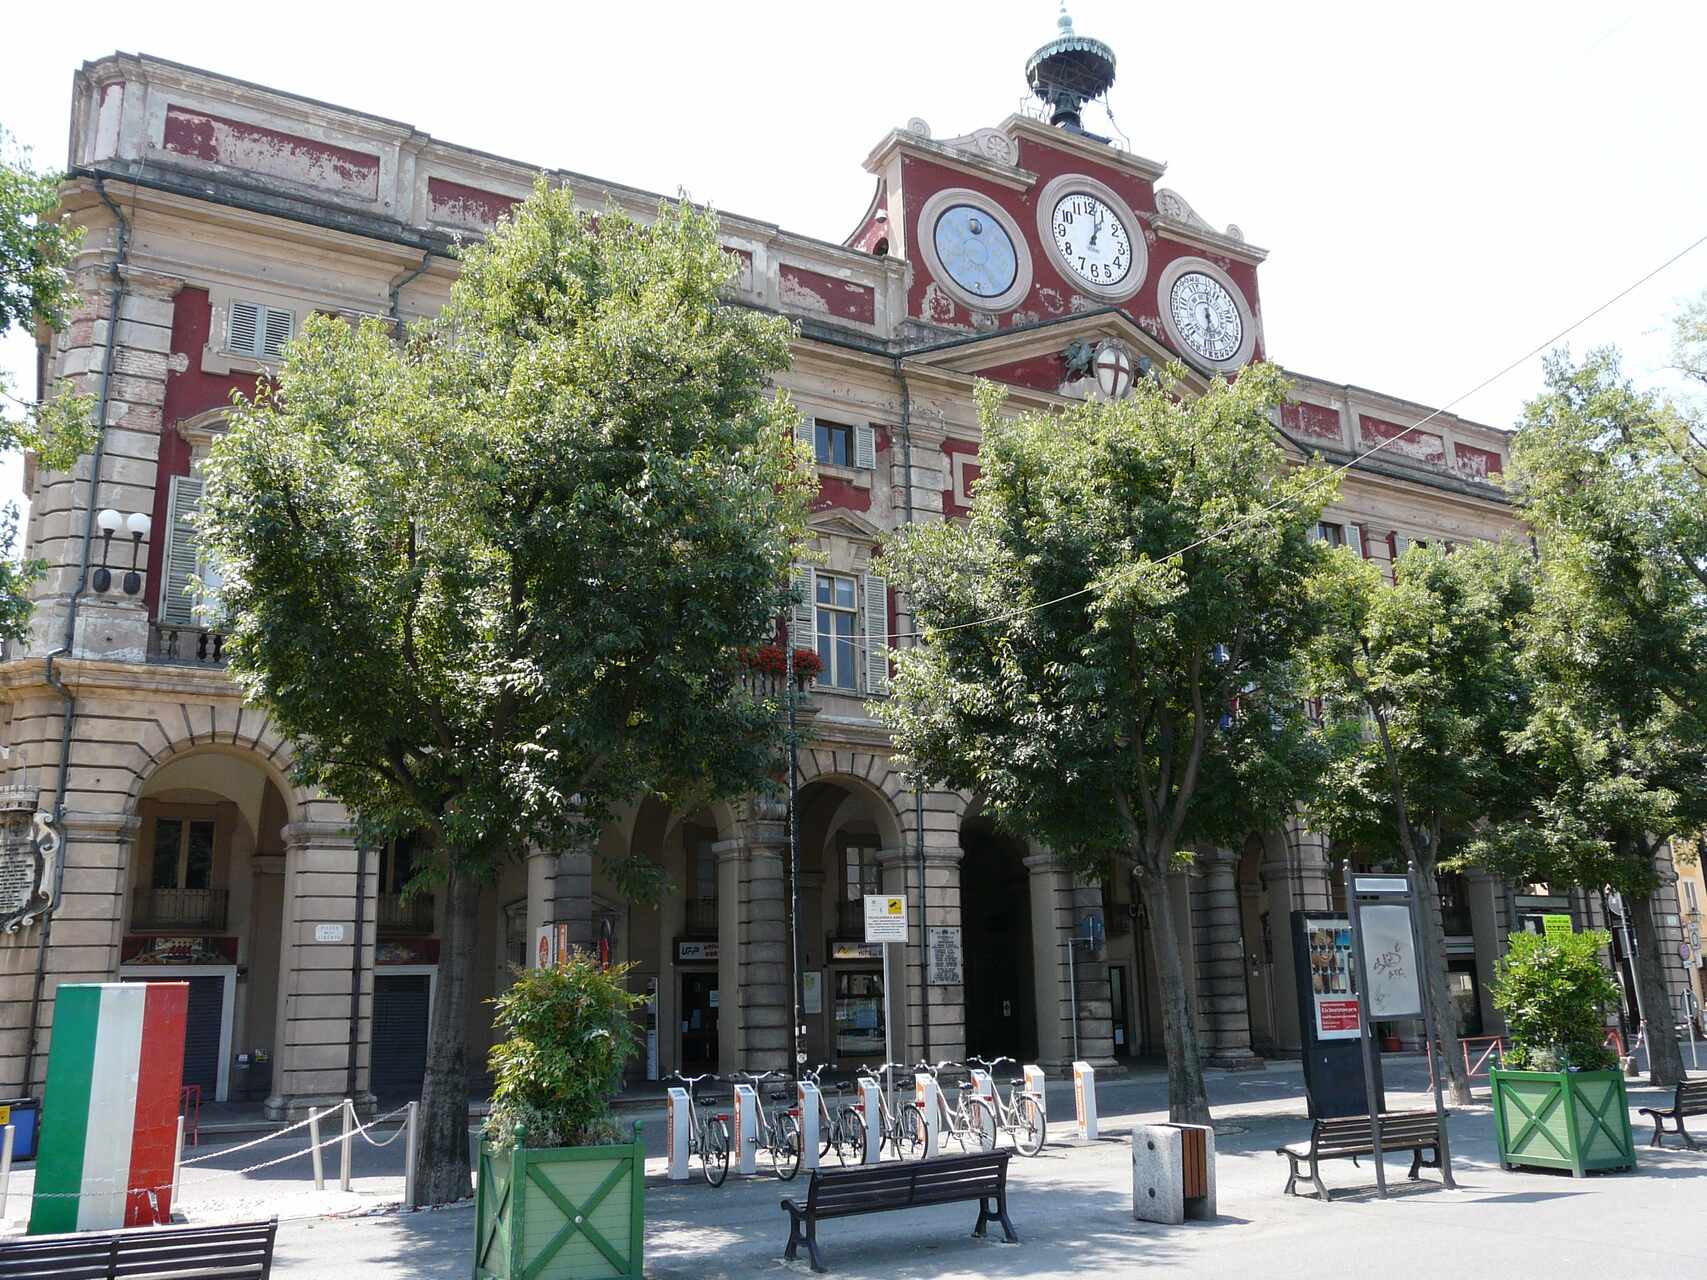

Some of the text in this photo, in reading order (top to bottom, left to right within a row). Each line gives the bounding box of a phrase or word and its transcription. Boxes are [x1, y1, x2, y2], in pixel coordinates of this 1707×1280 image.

[1073, 201, 1081, 216] 11
[1084, 201, 1096, 216] 12
[1062, 209, 1073, 225] 10
[1057, 223, 1066, 237] 9
[1111, 223, 1119, 238] 2
[1065, 241, 1072, 255] 8
[1117, 241, 1125, 255] 3
[1078, 256, 1086, 270] 7
[1113, 256, 1122, 269] 4
[1090, 263, 1099, 278] 6
[1104, 264, 1112, 278] 5
